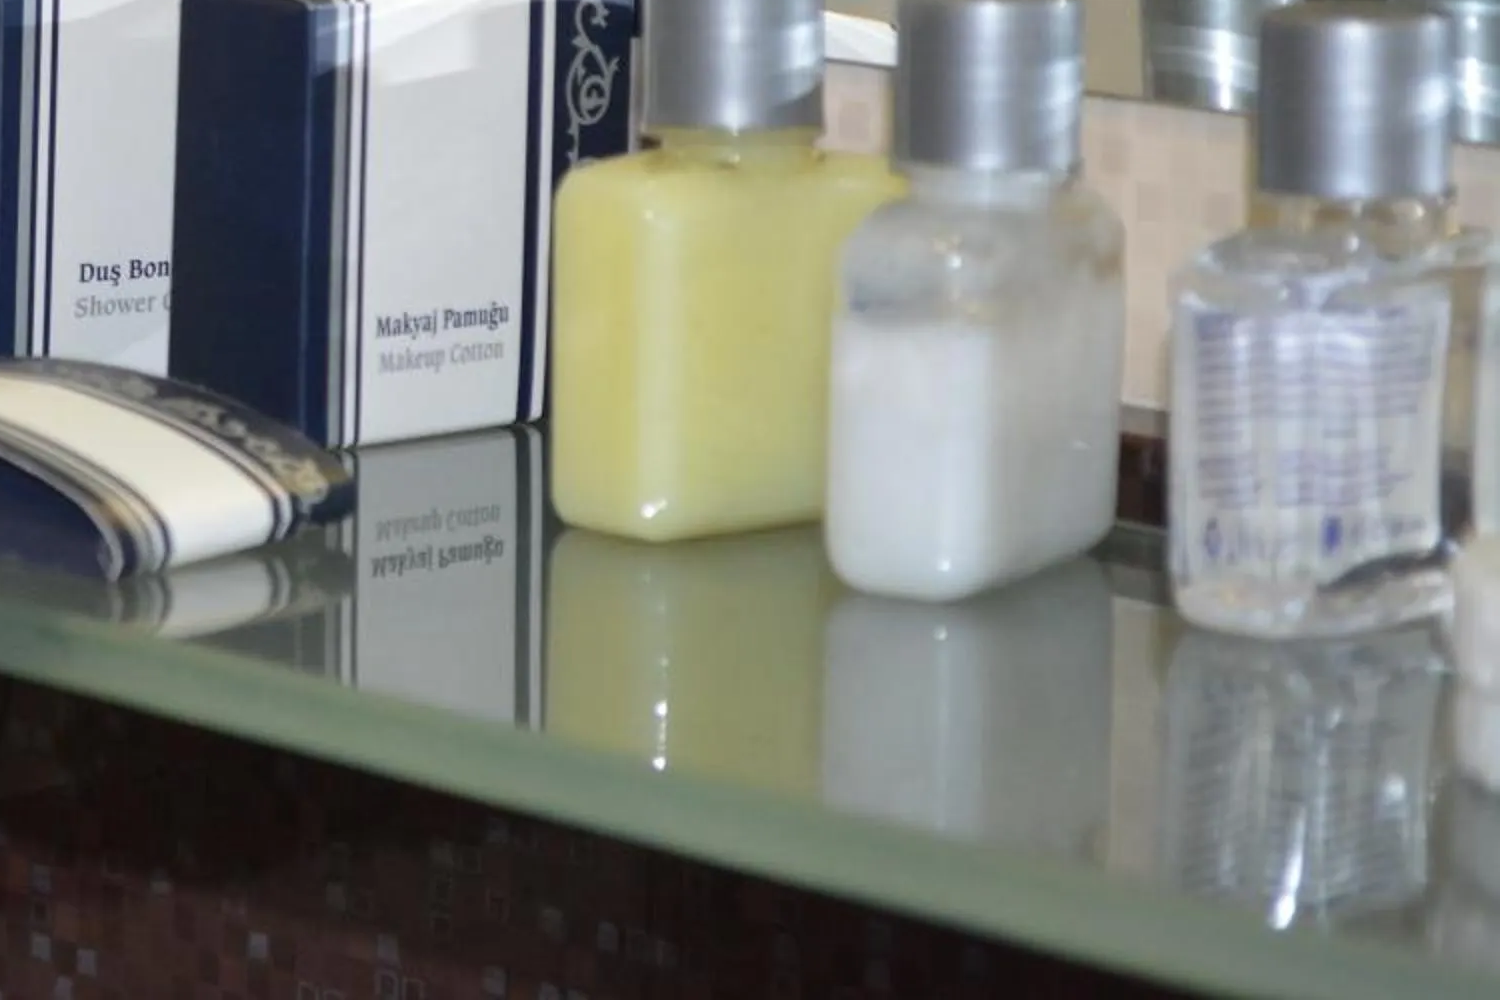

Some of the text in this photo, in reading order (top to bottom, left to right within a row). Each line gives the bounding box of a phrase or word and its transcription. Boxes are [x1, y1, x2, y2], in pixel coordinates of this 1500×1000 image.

[79, 262, 122, 287] Duş
[74, 295, 158, 319] Shower
[375, 309, 438, 340] Makyaj
[379, 341, 505, 375] Makeup Cotton
